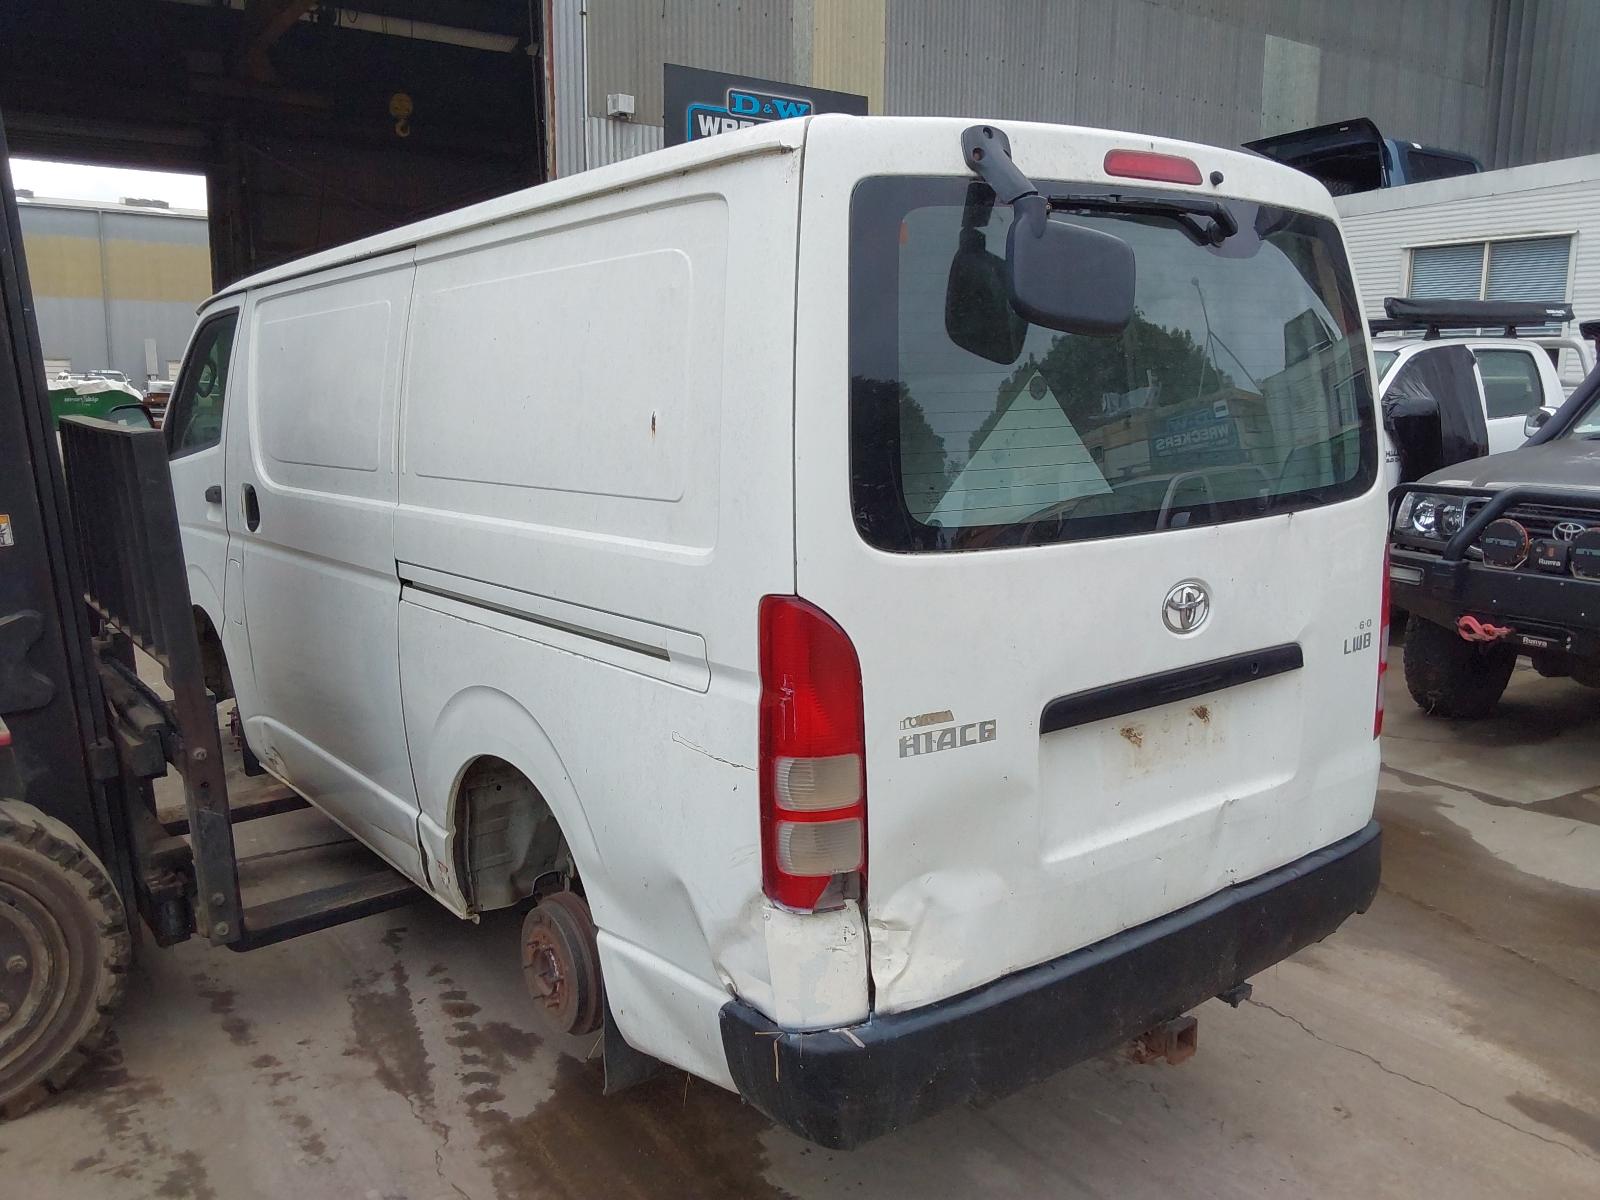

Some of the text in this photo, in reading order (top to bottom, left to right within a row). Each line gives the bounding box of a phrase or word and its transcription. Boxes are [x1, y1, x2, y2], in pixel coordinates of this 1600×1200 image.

[732, 93, 810, 120] D & W
[1343, 632, 1372, 655] LWB
